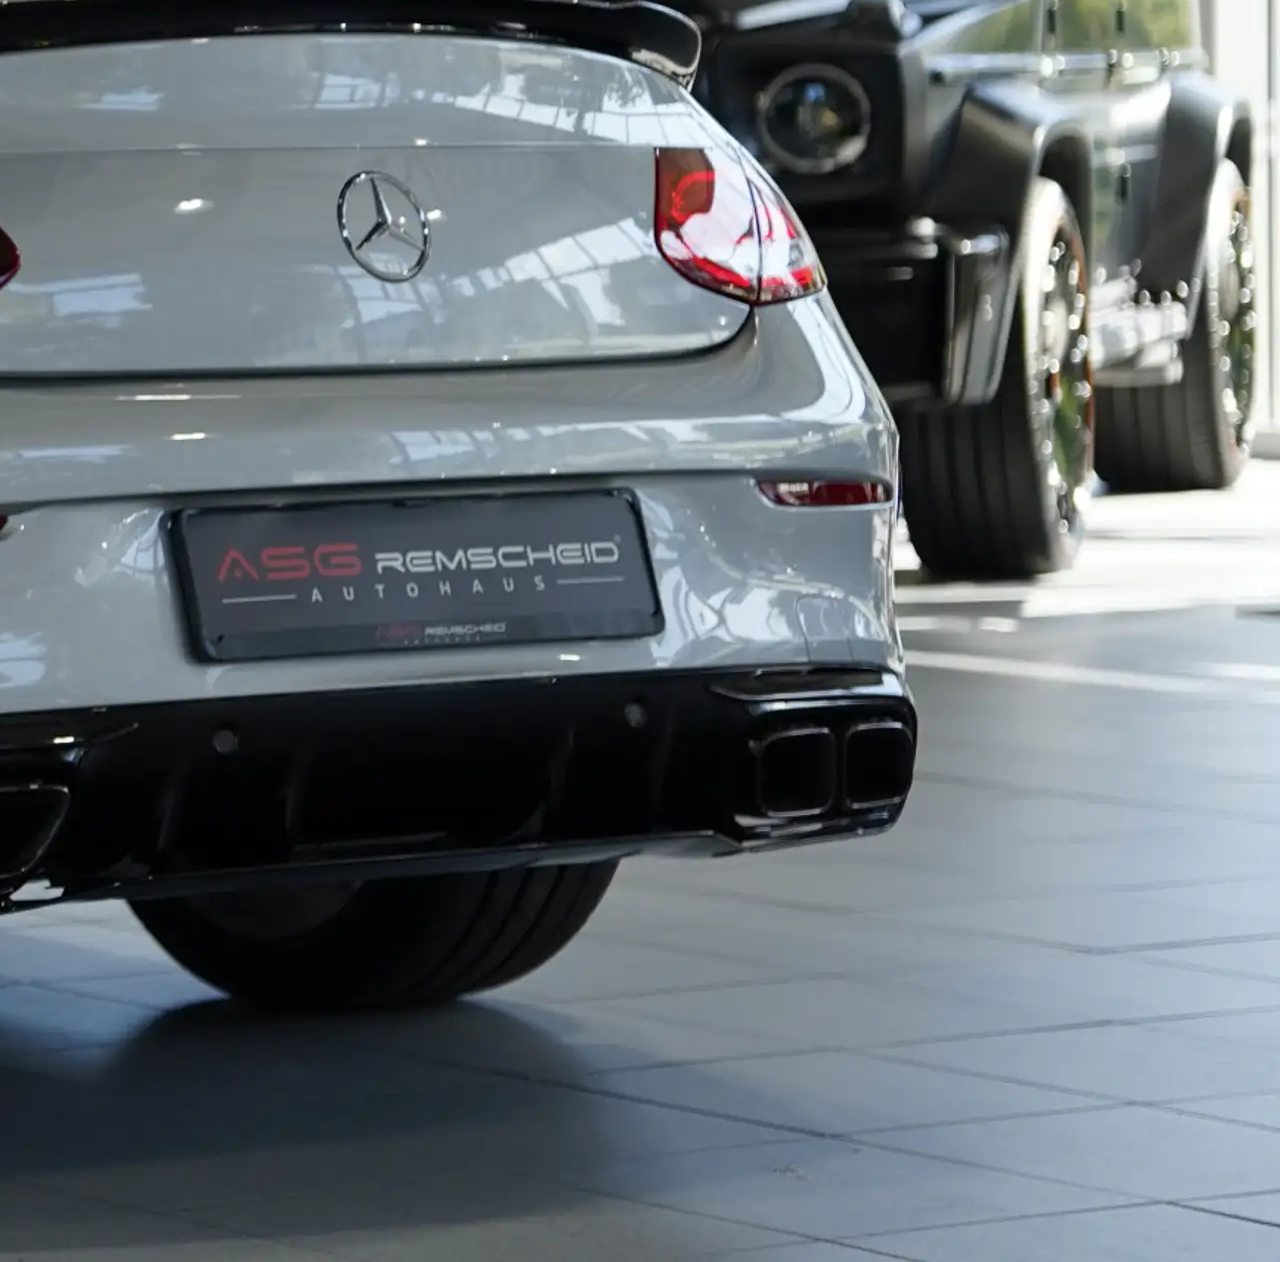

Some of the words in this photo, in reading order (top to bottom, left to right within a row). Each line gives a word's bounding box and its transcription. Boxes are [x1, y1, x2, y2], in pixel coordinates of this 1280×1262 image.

[218, 543, 362, 582] ASG
[375, 540, 620, 575] REMSCHEID
[311, 576, 546, 603] AUTOHAUS
